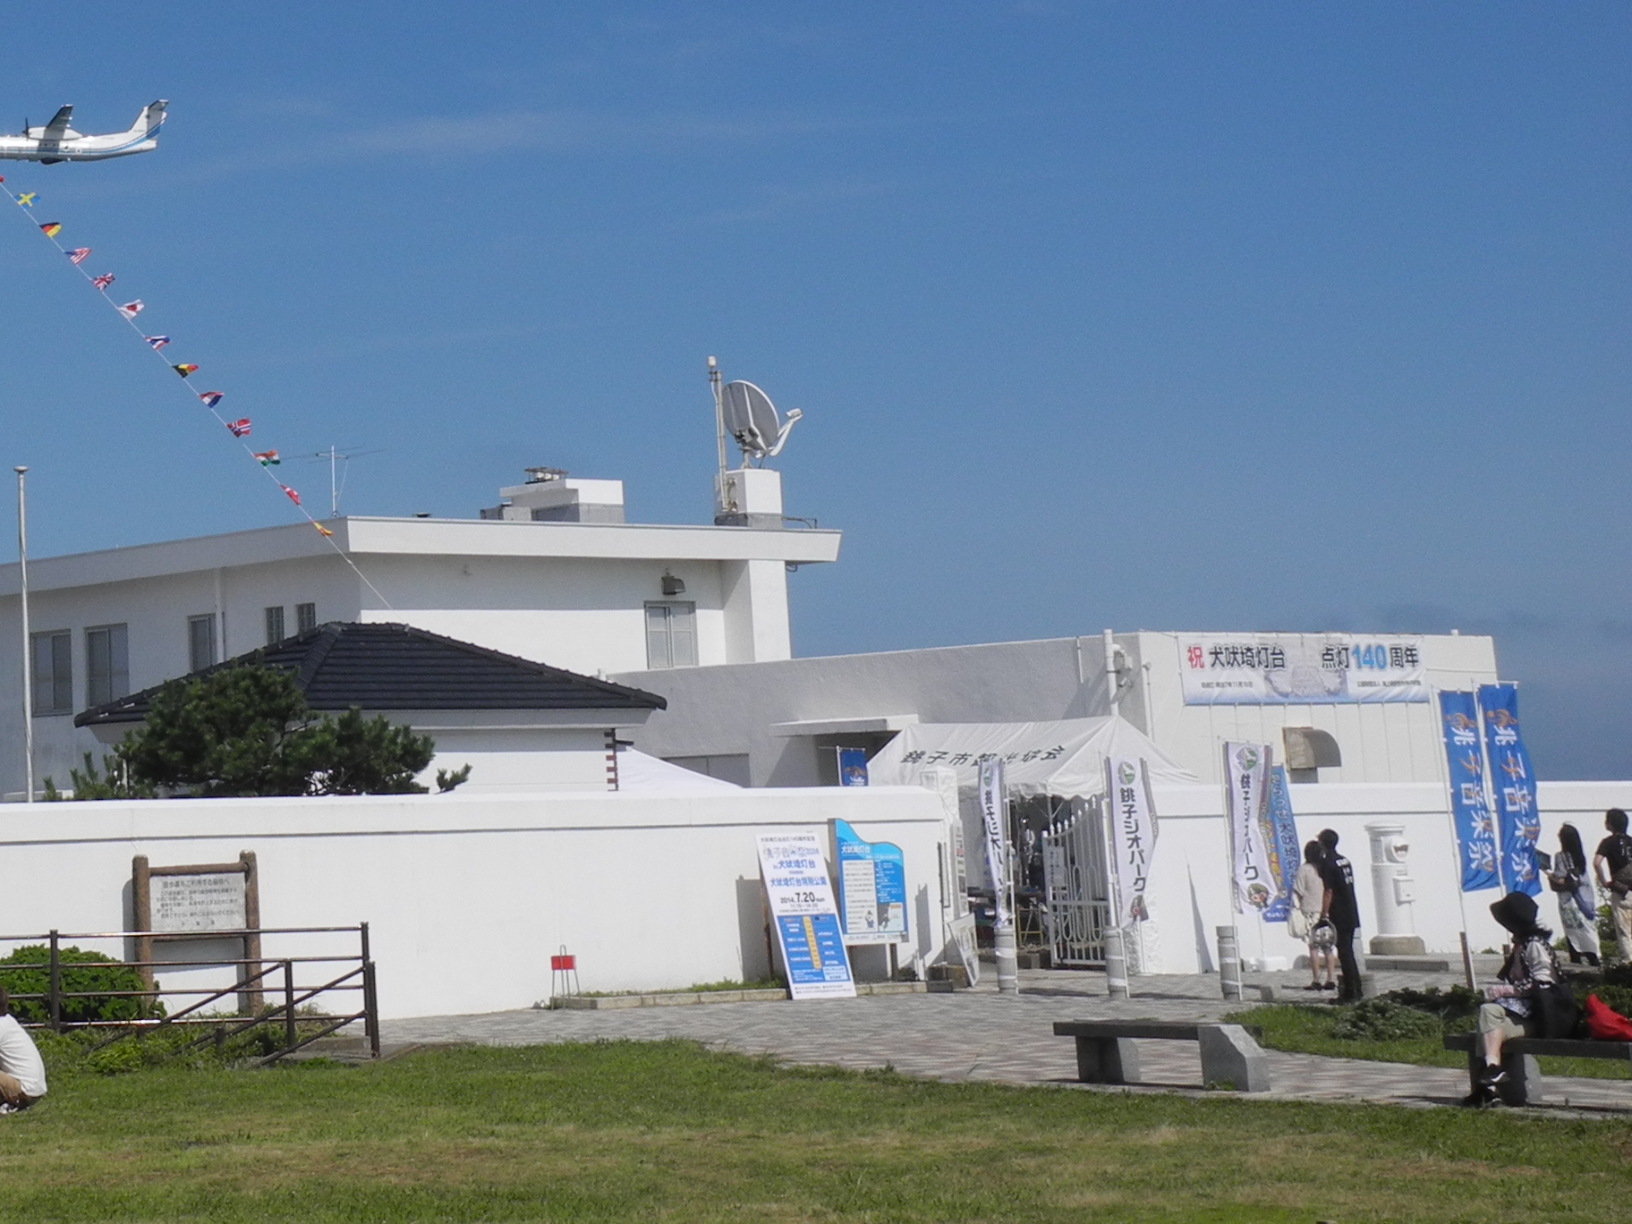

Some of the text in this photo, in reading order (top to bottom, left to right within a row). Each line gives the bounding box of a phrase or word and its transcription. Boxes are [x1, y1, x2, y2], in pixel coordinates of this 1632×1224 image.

[1187, 646, 1205, 669] 祝
[1120, 787, 1146, 892] 銚子ジオパーク
